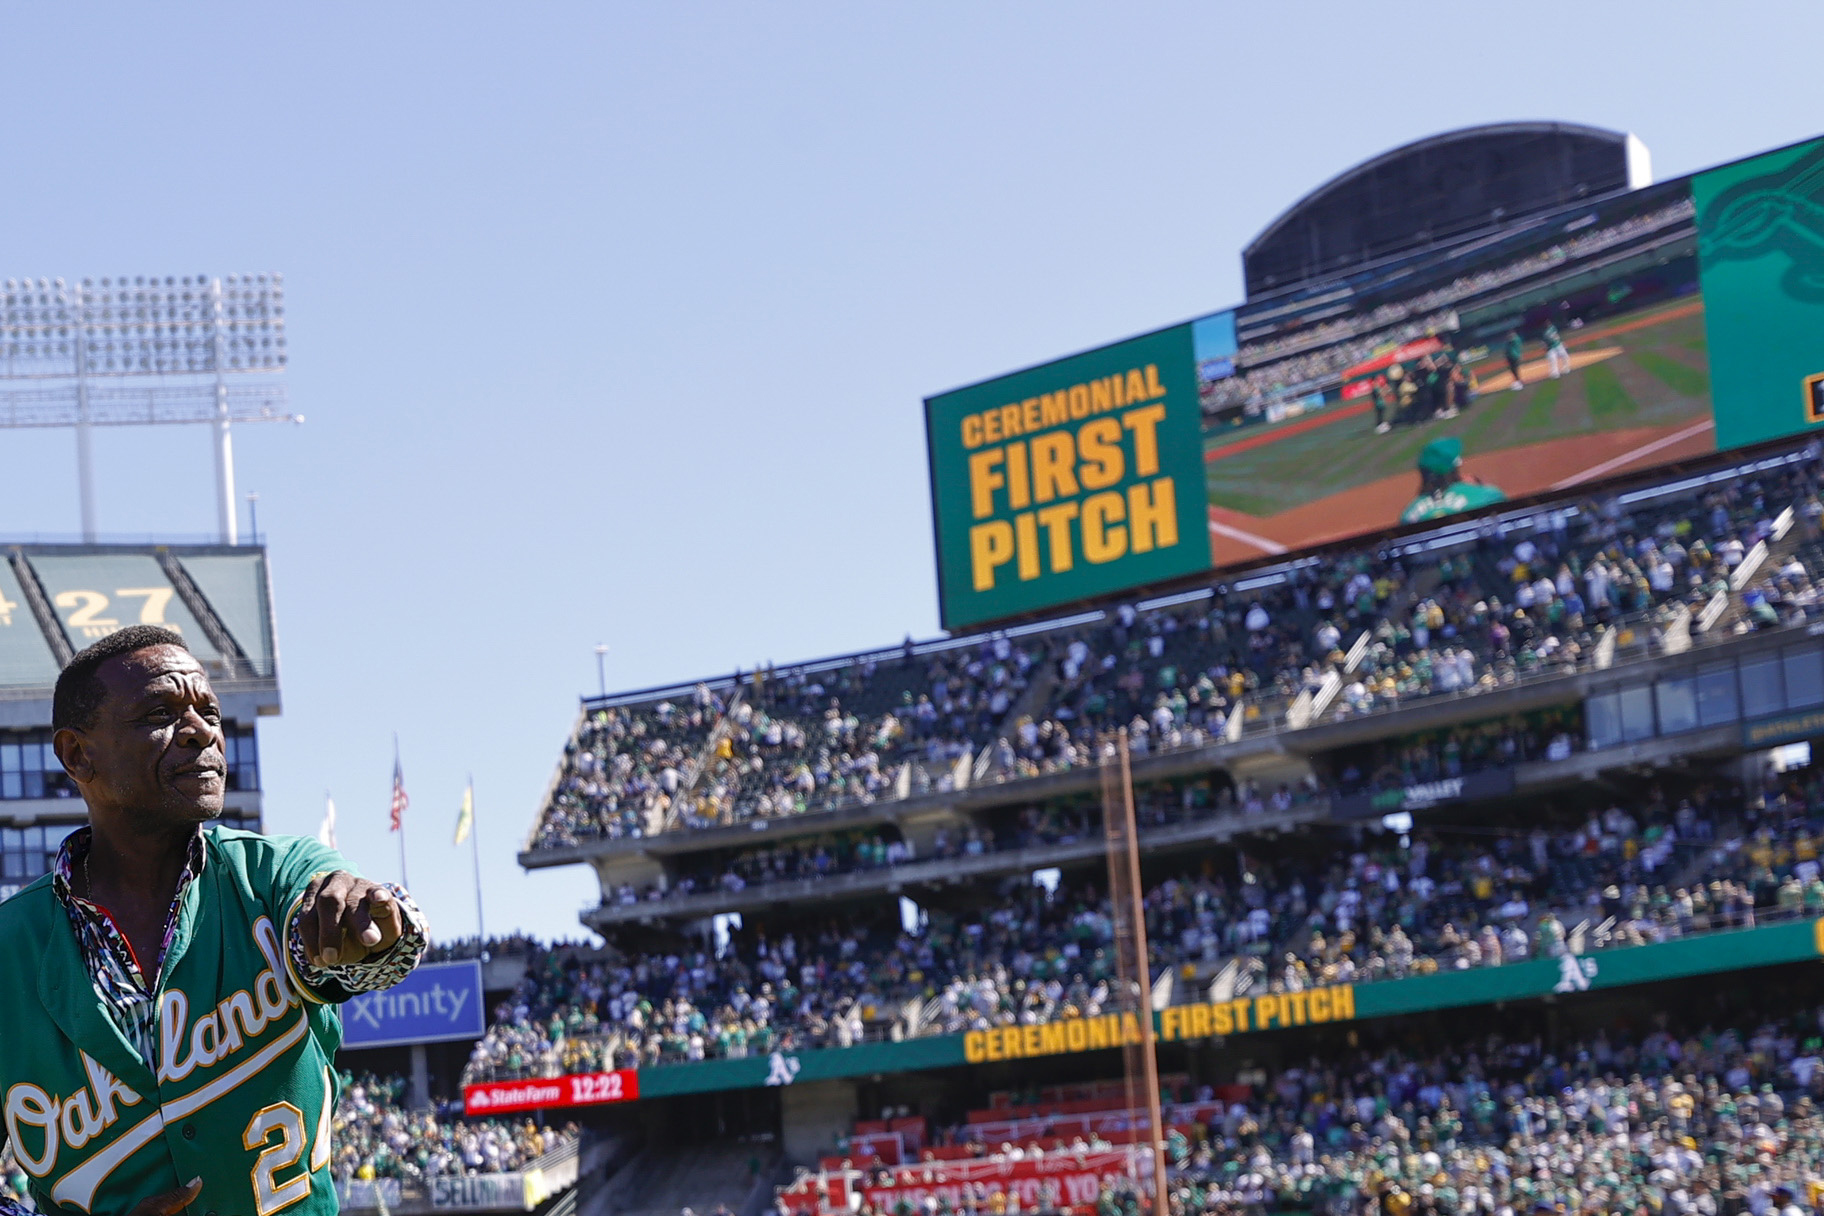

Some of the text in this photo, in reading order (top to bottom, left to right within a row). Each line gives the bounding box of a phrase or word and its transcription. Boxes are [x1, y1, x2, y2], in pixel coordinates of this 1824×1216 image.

[961, 363, 1166, 449] CEREMONIAL
[969, 403, 1166, 519] FIRST
[970, 476, 1178, 592] PITCH
[55, 587, 174, 627] 27
[352, 983, 469, 1029] xfinity
[964, 983, 1355, 1063] CEREMONIA FIRST PITCH
[571, 1074, 623, 1103] 12:22
